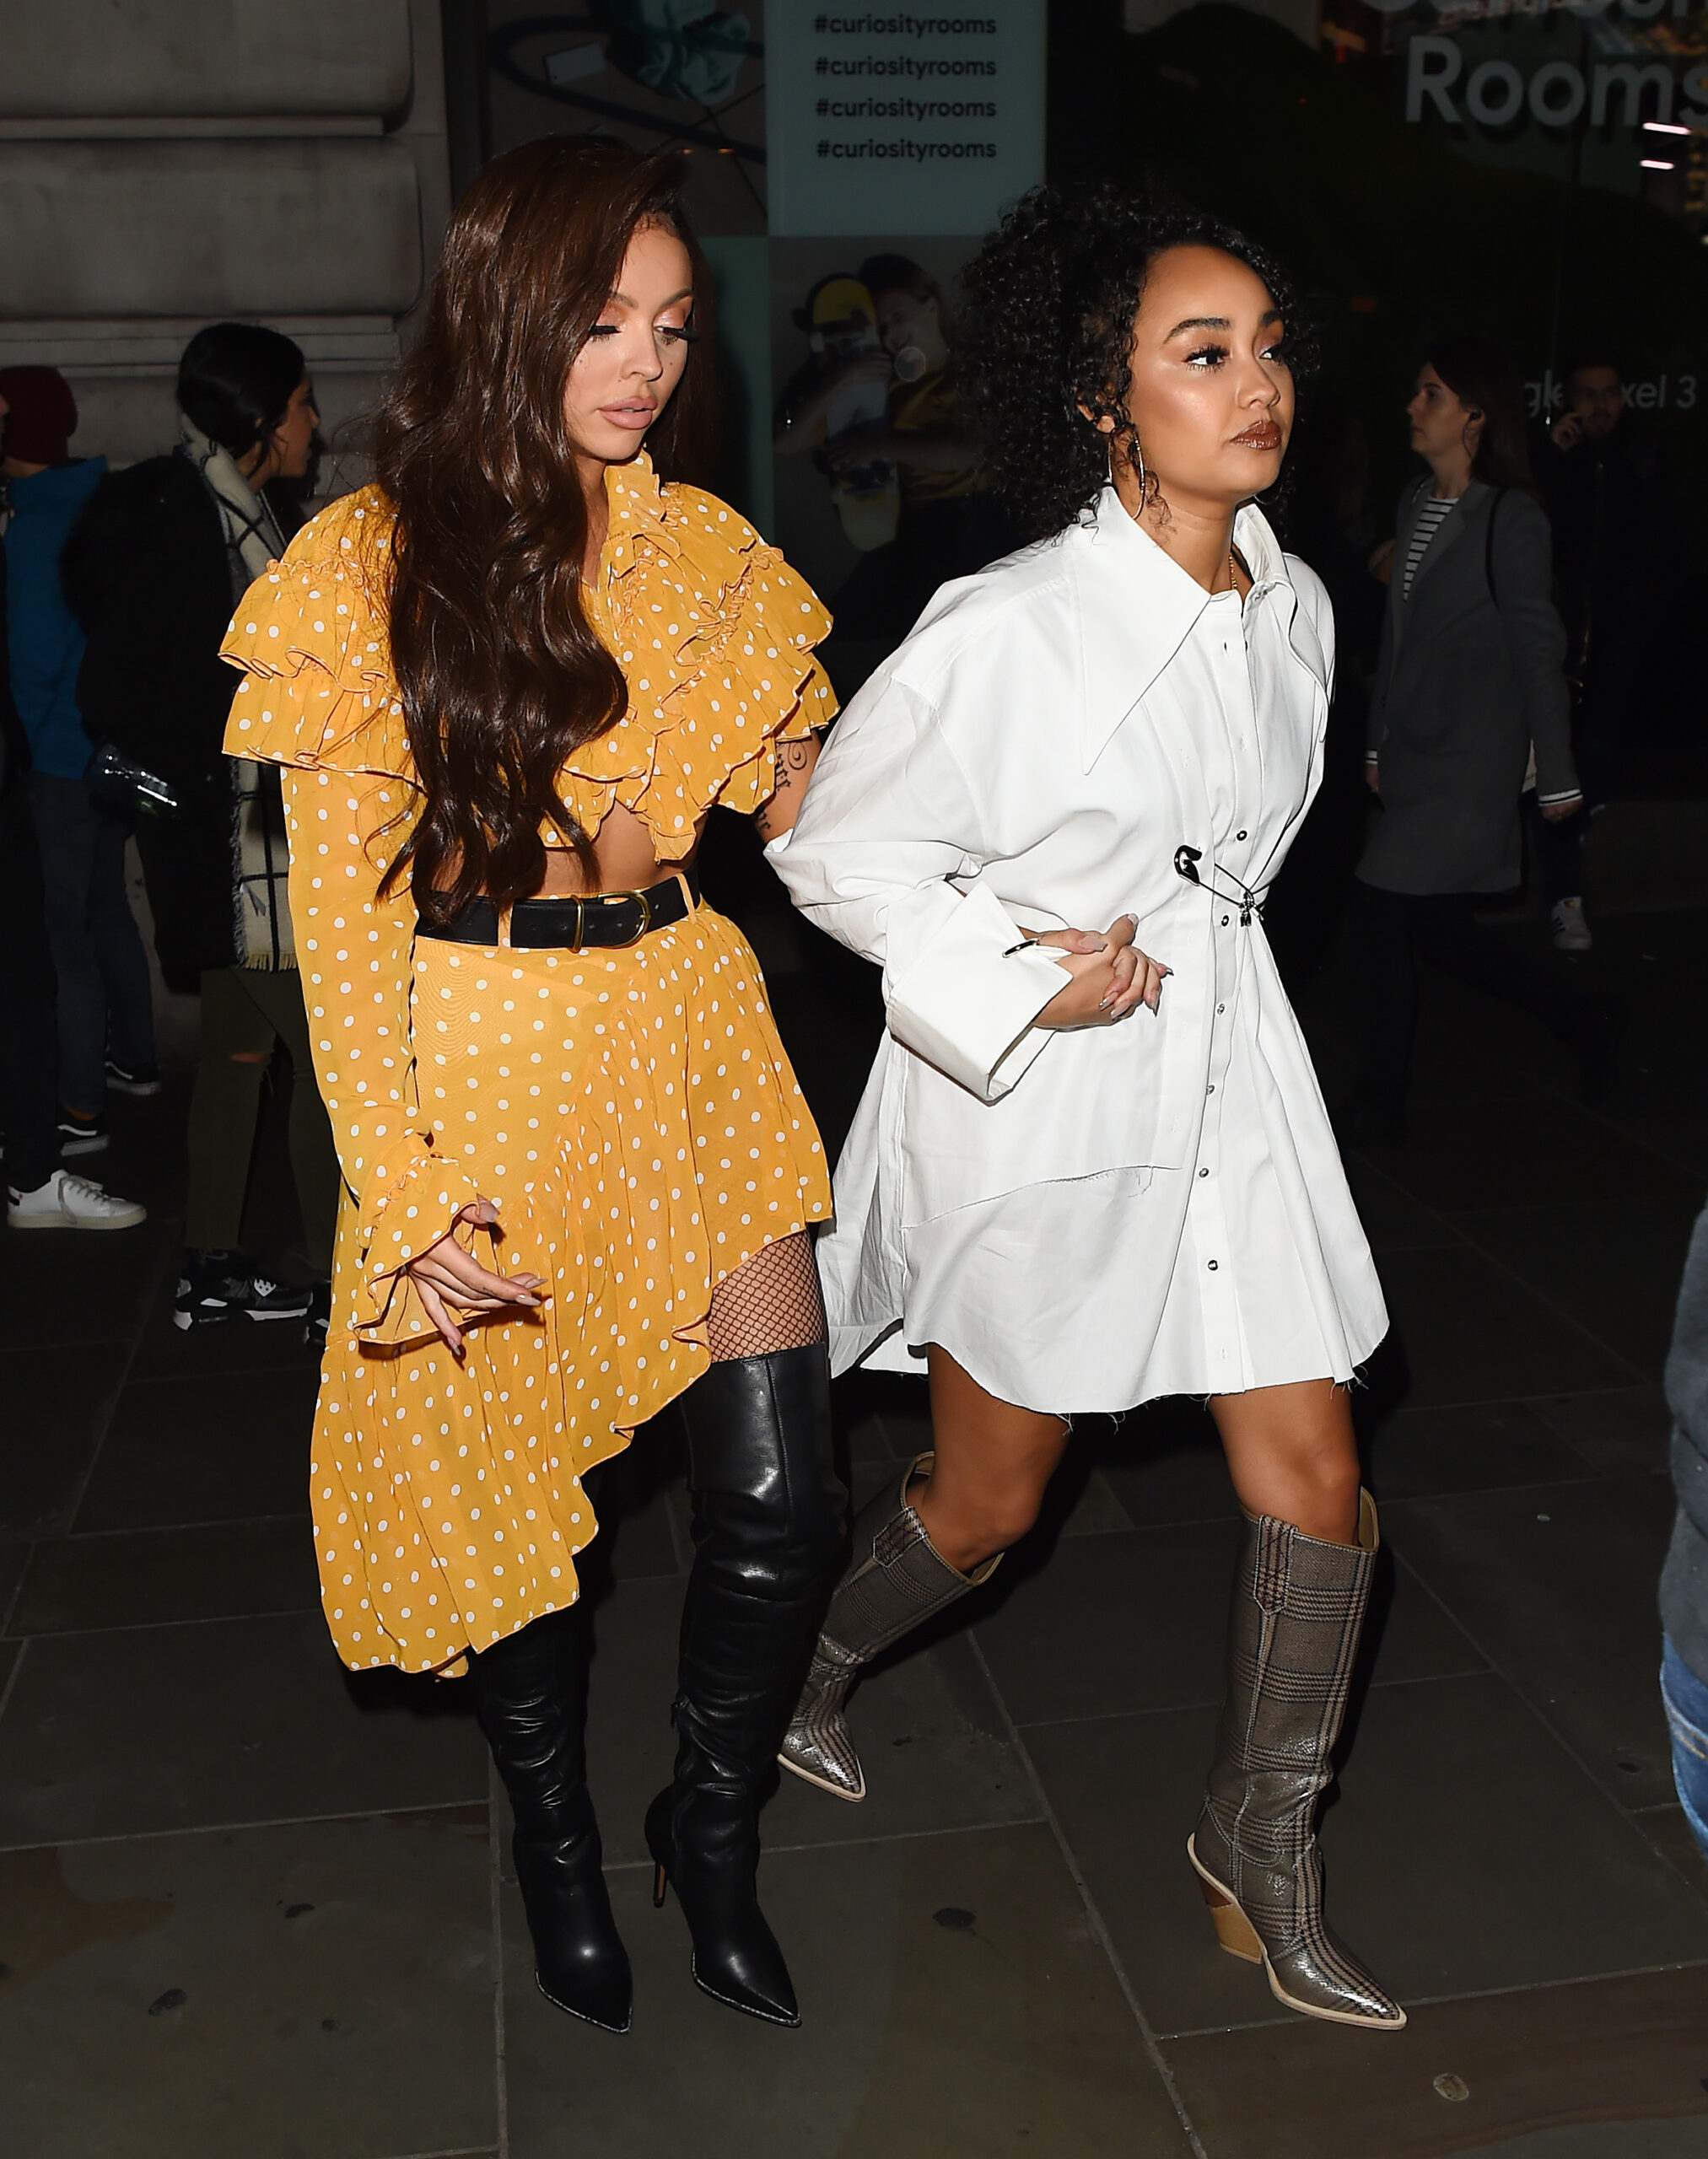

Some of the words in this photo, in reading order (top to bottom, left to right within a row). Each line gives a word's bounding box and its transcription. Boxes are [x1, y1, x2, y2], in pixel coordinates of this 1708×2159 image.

[815, 13, 997, 38] #curiosityrooms
[816, 56, 997, 80] #curiosityrooms
[816, 98, 997, 121] #curiosityrooms
[816, 139, 997, 162] #curiosityrooms
[1620, 374, 1667, 408] xel
[1676, 375, 1697, 409] 3
